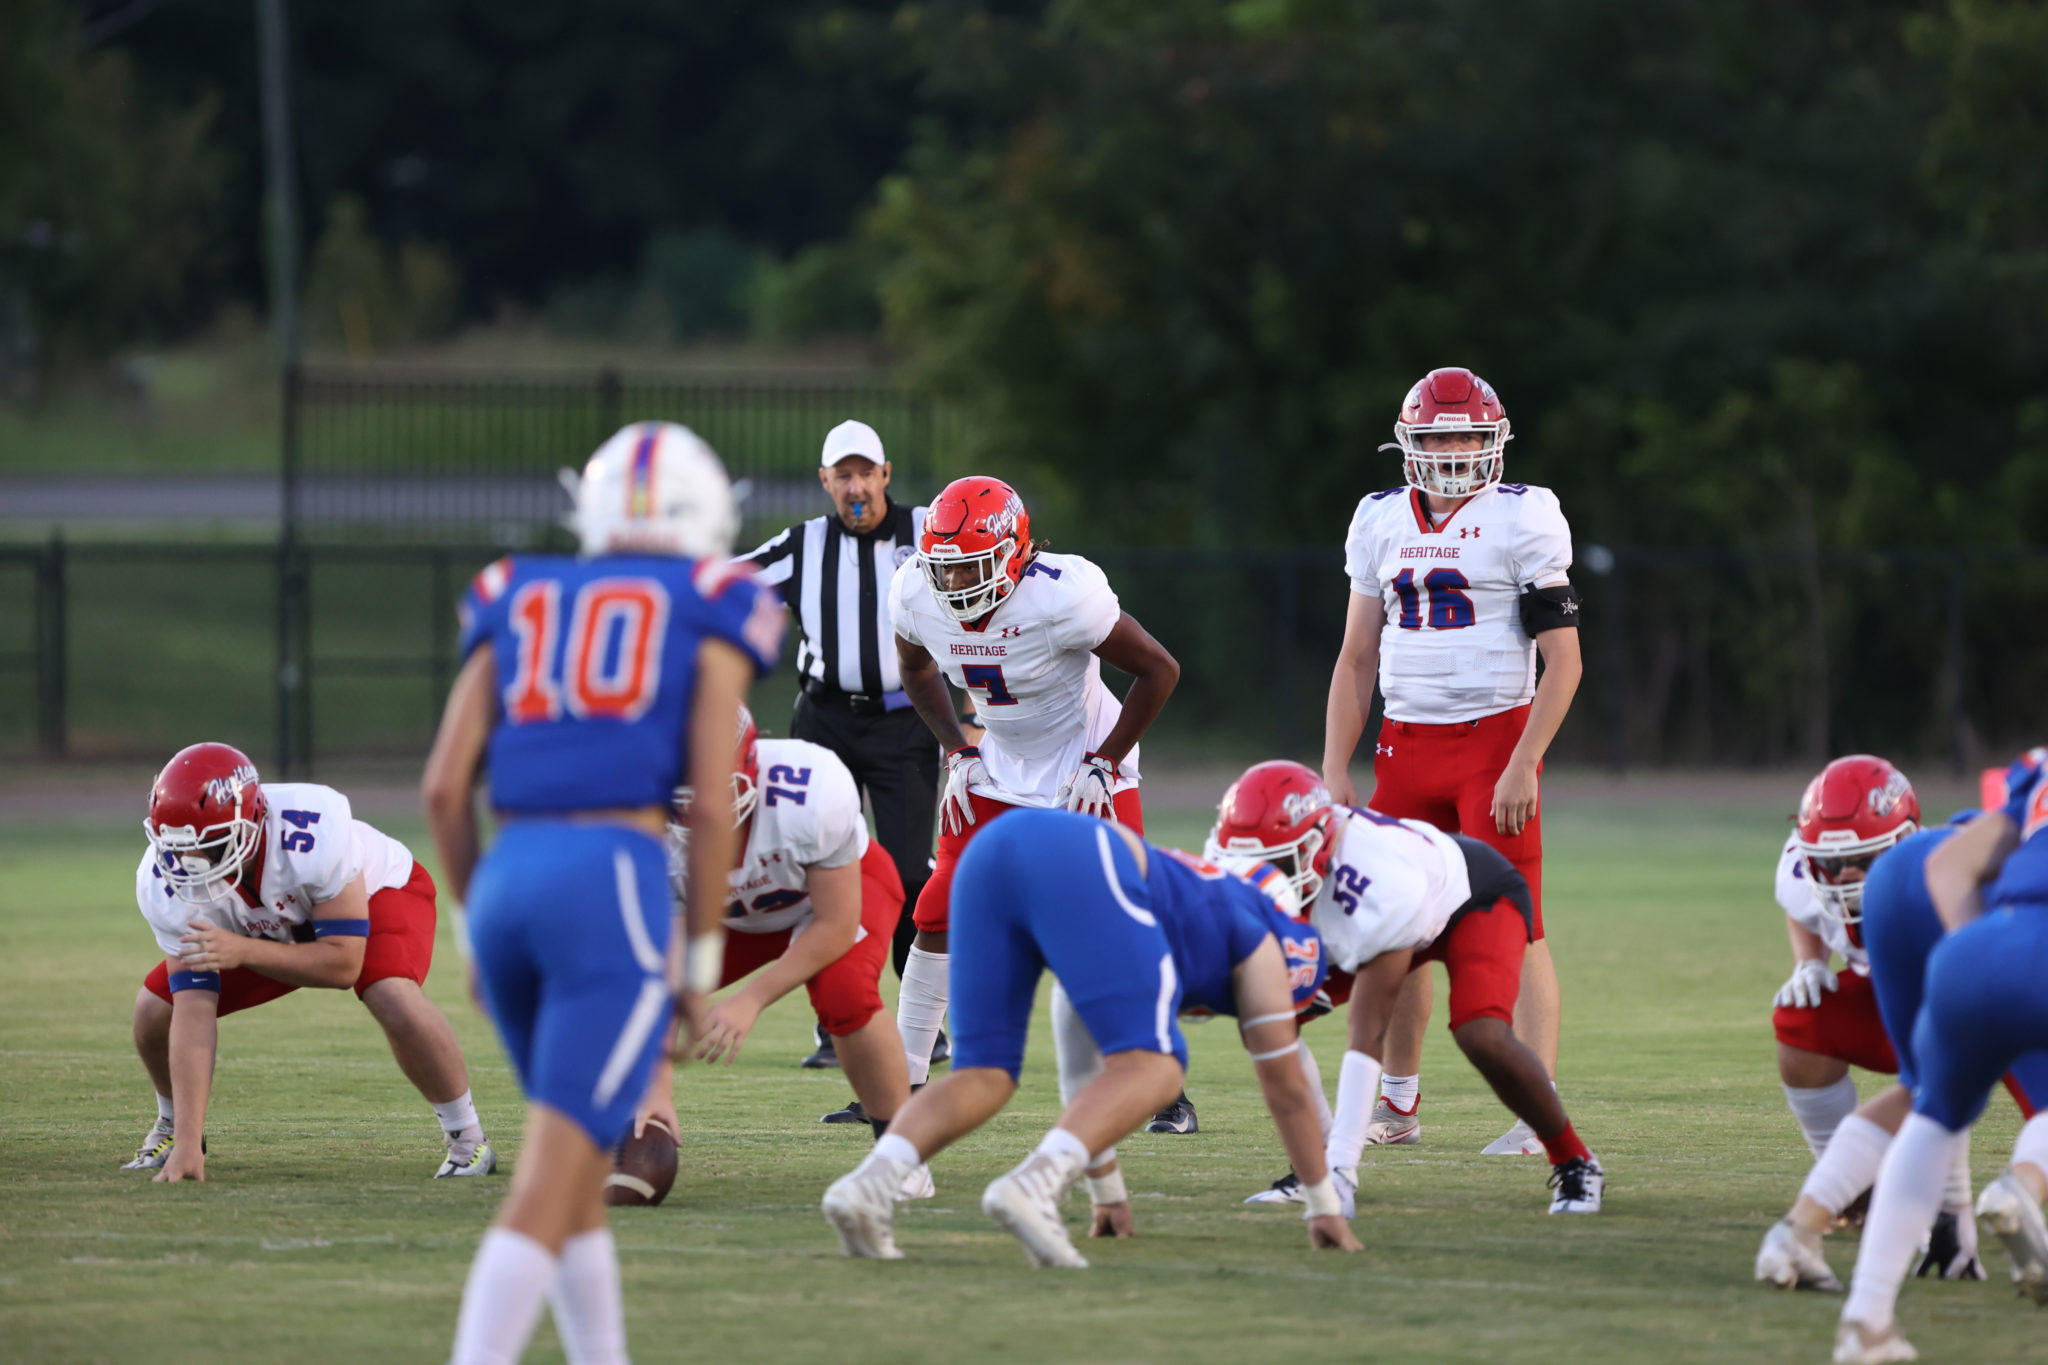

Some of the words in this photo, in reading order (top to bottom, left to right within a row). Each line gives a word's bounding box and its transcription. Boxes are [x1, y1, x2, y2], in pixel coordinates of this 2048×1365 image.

[1025, 561, 1062, 580] 7
[1400, 547, 1460, 559] HERITAGE
[1391, 567, 1476, 630] 16
[504, 576, 671, 724] 10
[950, 643, 1007, 656] HERITAGE
[962, 664, 1018, 706] 7
[765, 764, 812, 807] 72
[281, 809, 321, 853] 54
[1332, 864, 1372, 916] 52
